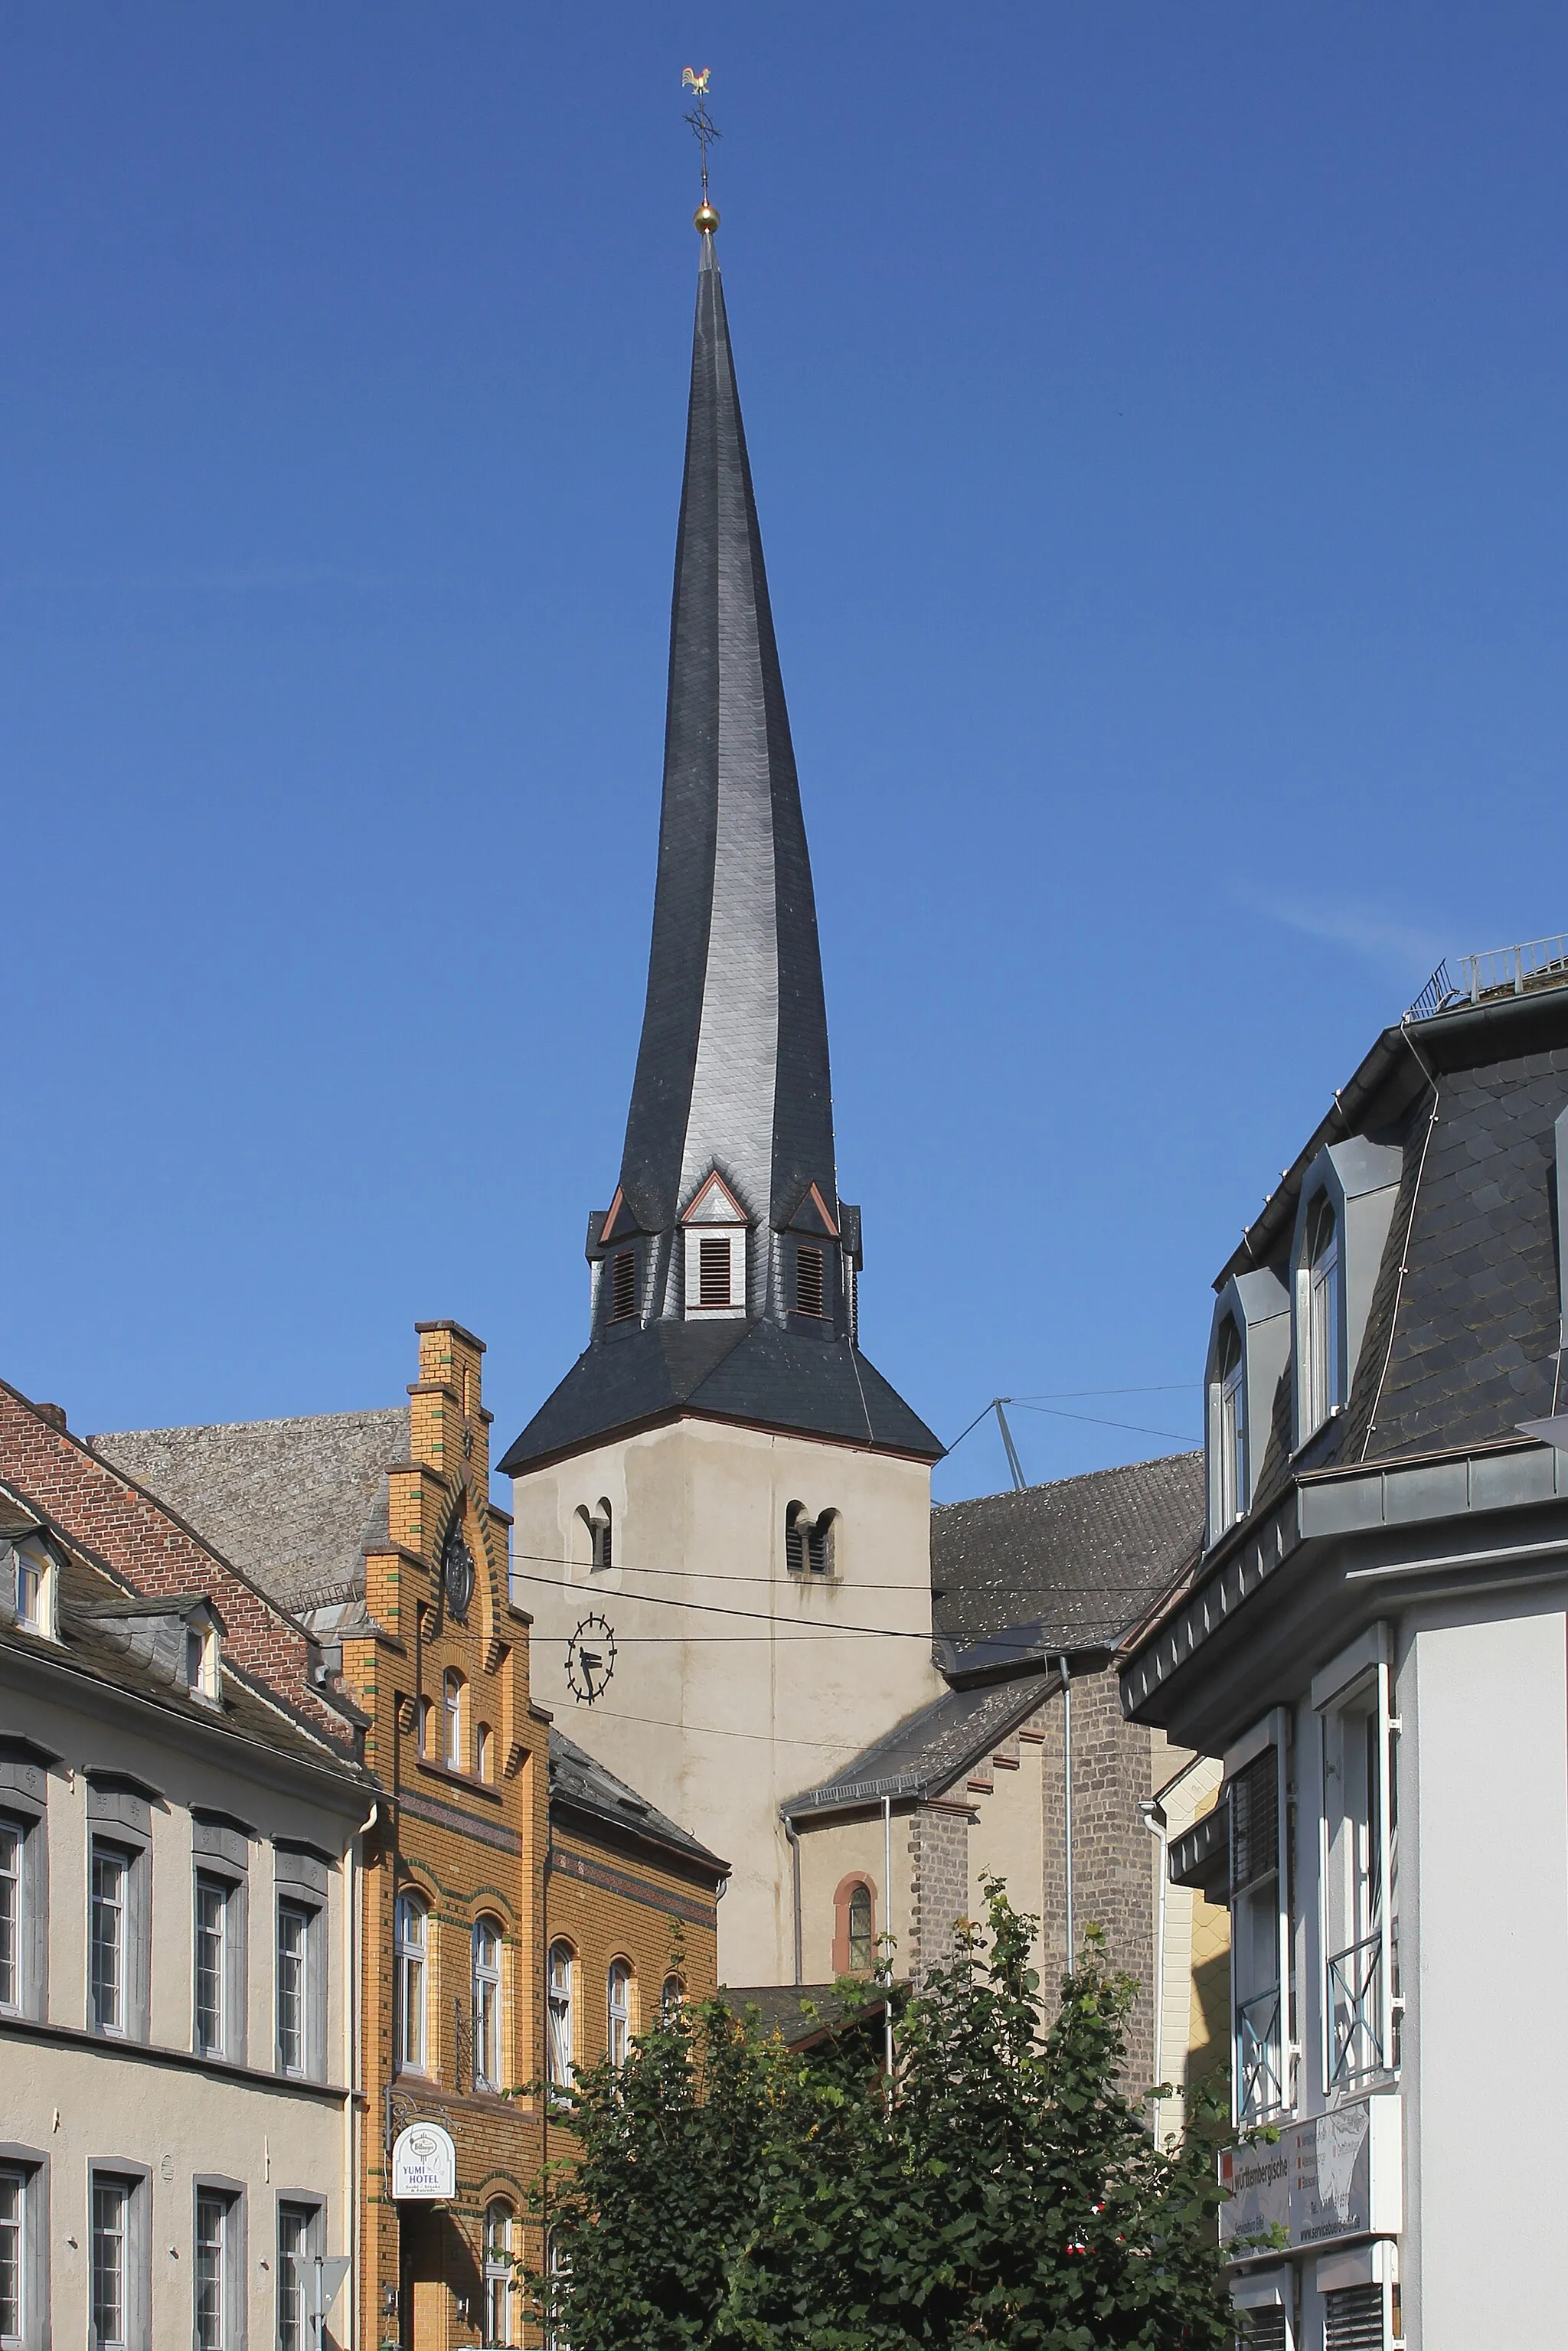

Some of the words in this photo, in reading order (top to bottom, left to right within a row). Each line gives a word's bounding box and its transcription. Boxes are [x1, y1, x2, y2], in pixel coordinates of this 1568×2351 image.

[403, 2166, 425, 2175] YUMI
[1234, 2155, 1288, 2191] württembergische
[410, 2175, 439, 2183] HOTEL
